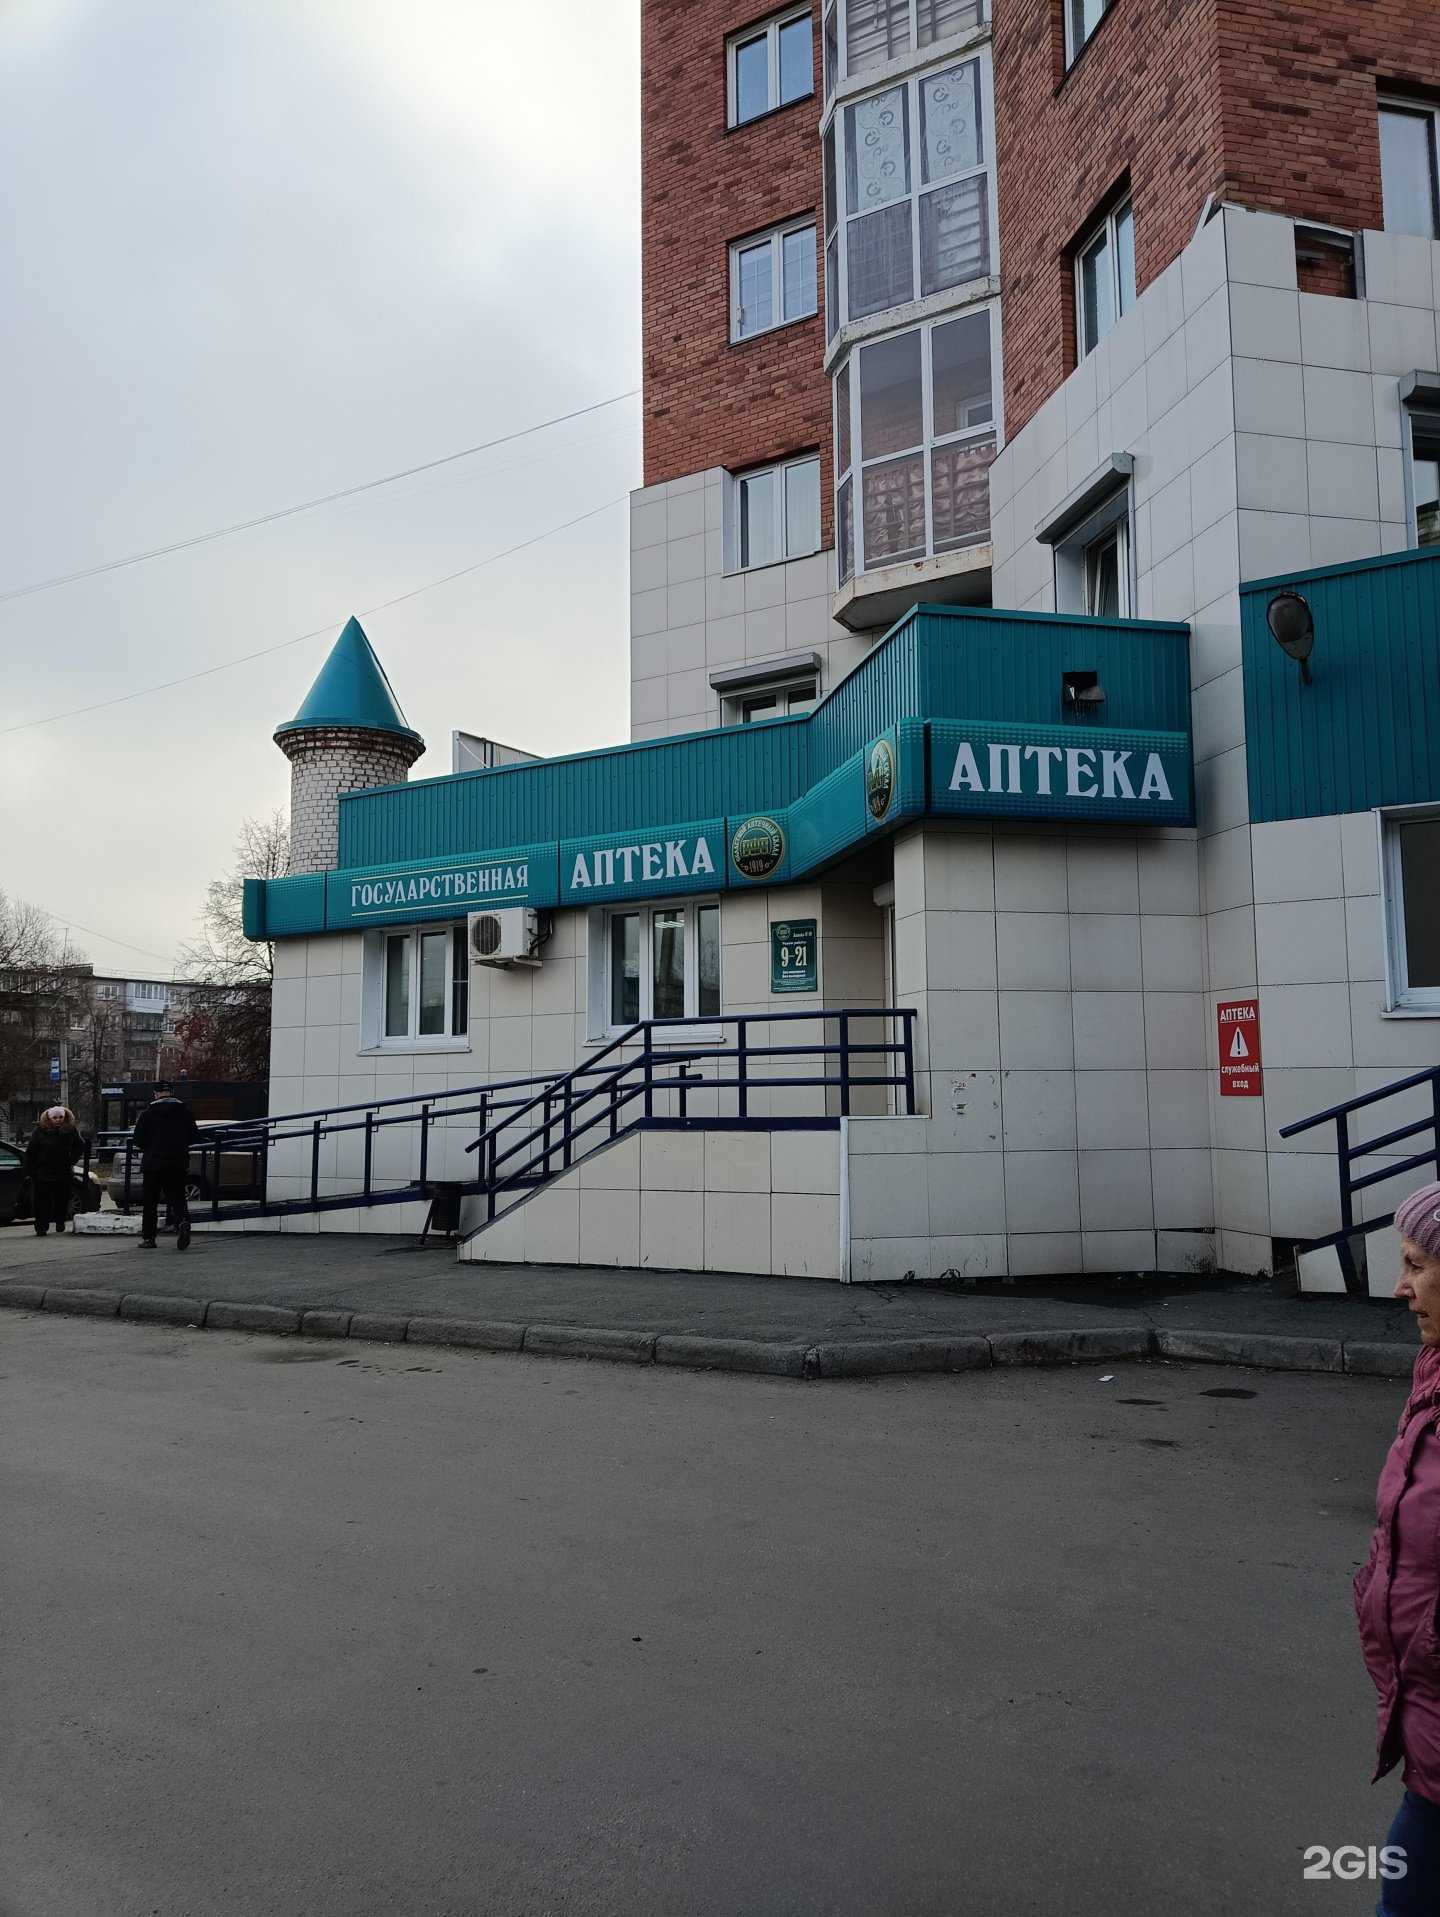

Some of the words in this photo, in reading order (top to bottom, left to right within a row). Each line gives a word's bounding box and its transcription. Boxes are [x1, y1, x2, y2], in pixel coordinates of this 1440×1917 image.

[948, 742, 1174, 800] АПТЕКА
[351, 864, 528, 907] ГОСУДАРСТВЕННАЯ
[570, 837, 715, 889] АПТЕКА
[1220, 1007, 1256, 1021] АПТЕКА
[1221, 1063, 1260, 1075] служебный
[1232, 1080, 1249, 1089] вход
